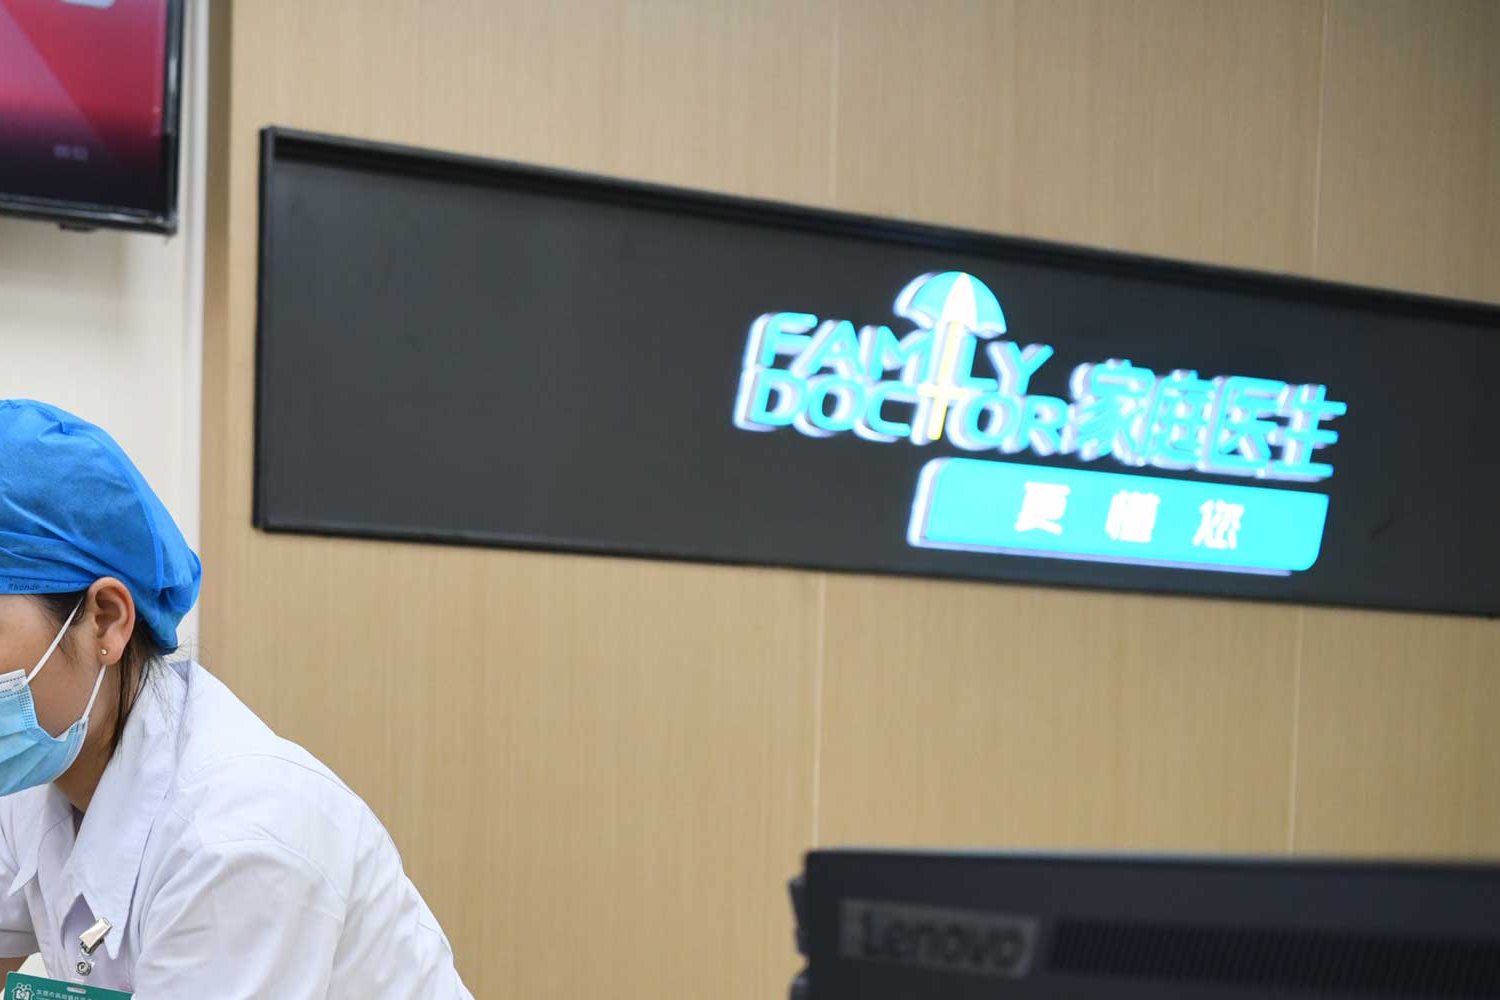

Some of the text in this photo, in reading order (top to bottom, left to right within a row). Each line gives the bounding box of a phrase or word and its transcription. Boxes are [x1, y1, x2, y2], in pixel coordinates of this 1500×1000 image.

[742, 311, 1054, 397] FAMILY
[734, 366, 1074, 458] DOCTOR
[1064, 358, 1347, 482] 家庭医生
[1014, 481, 1246, 550] 更懂您
[861, 909, 1026, 968] Lenovo
